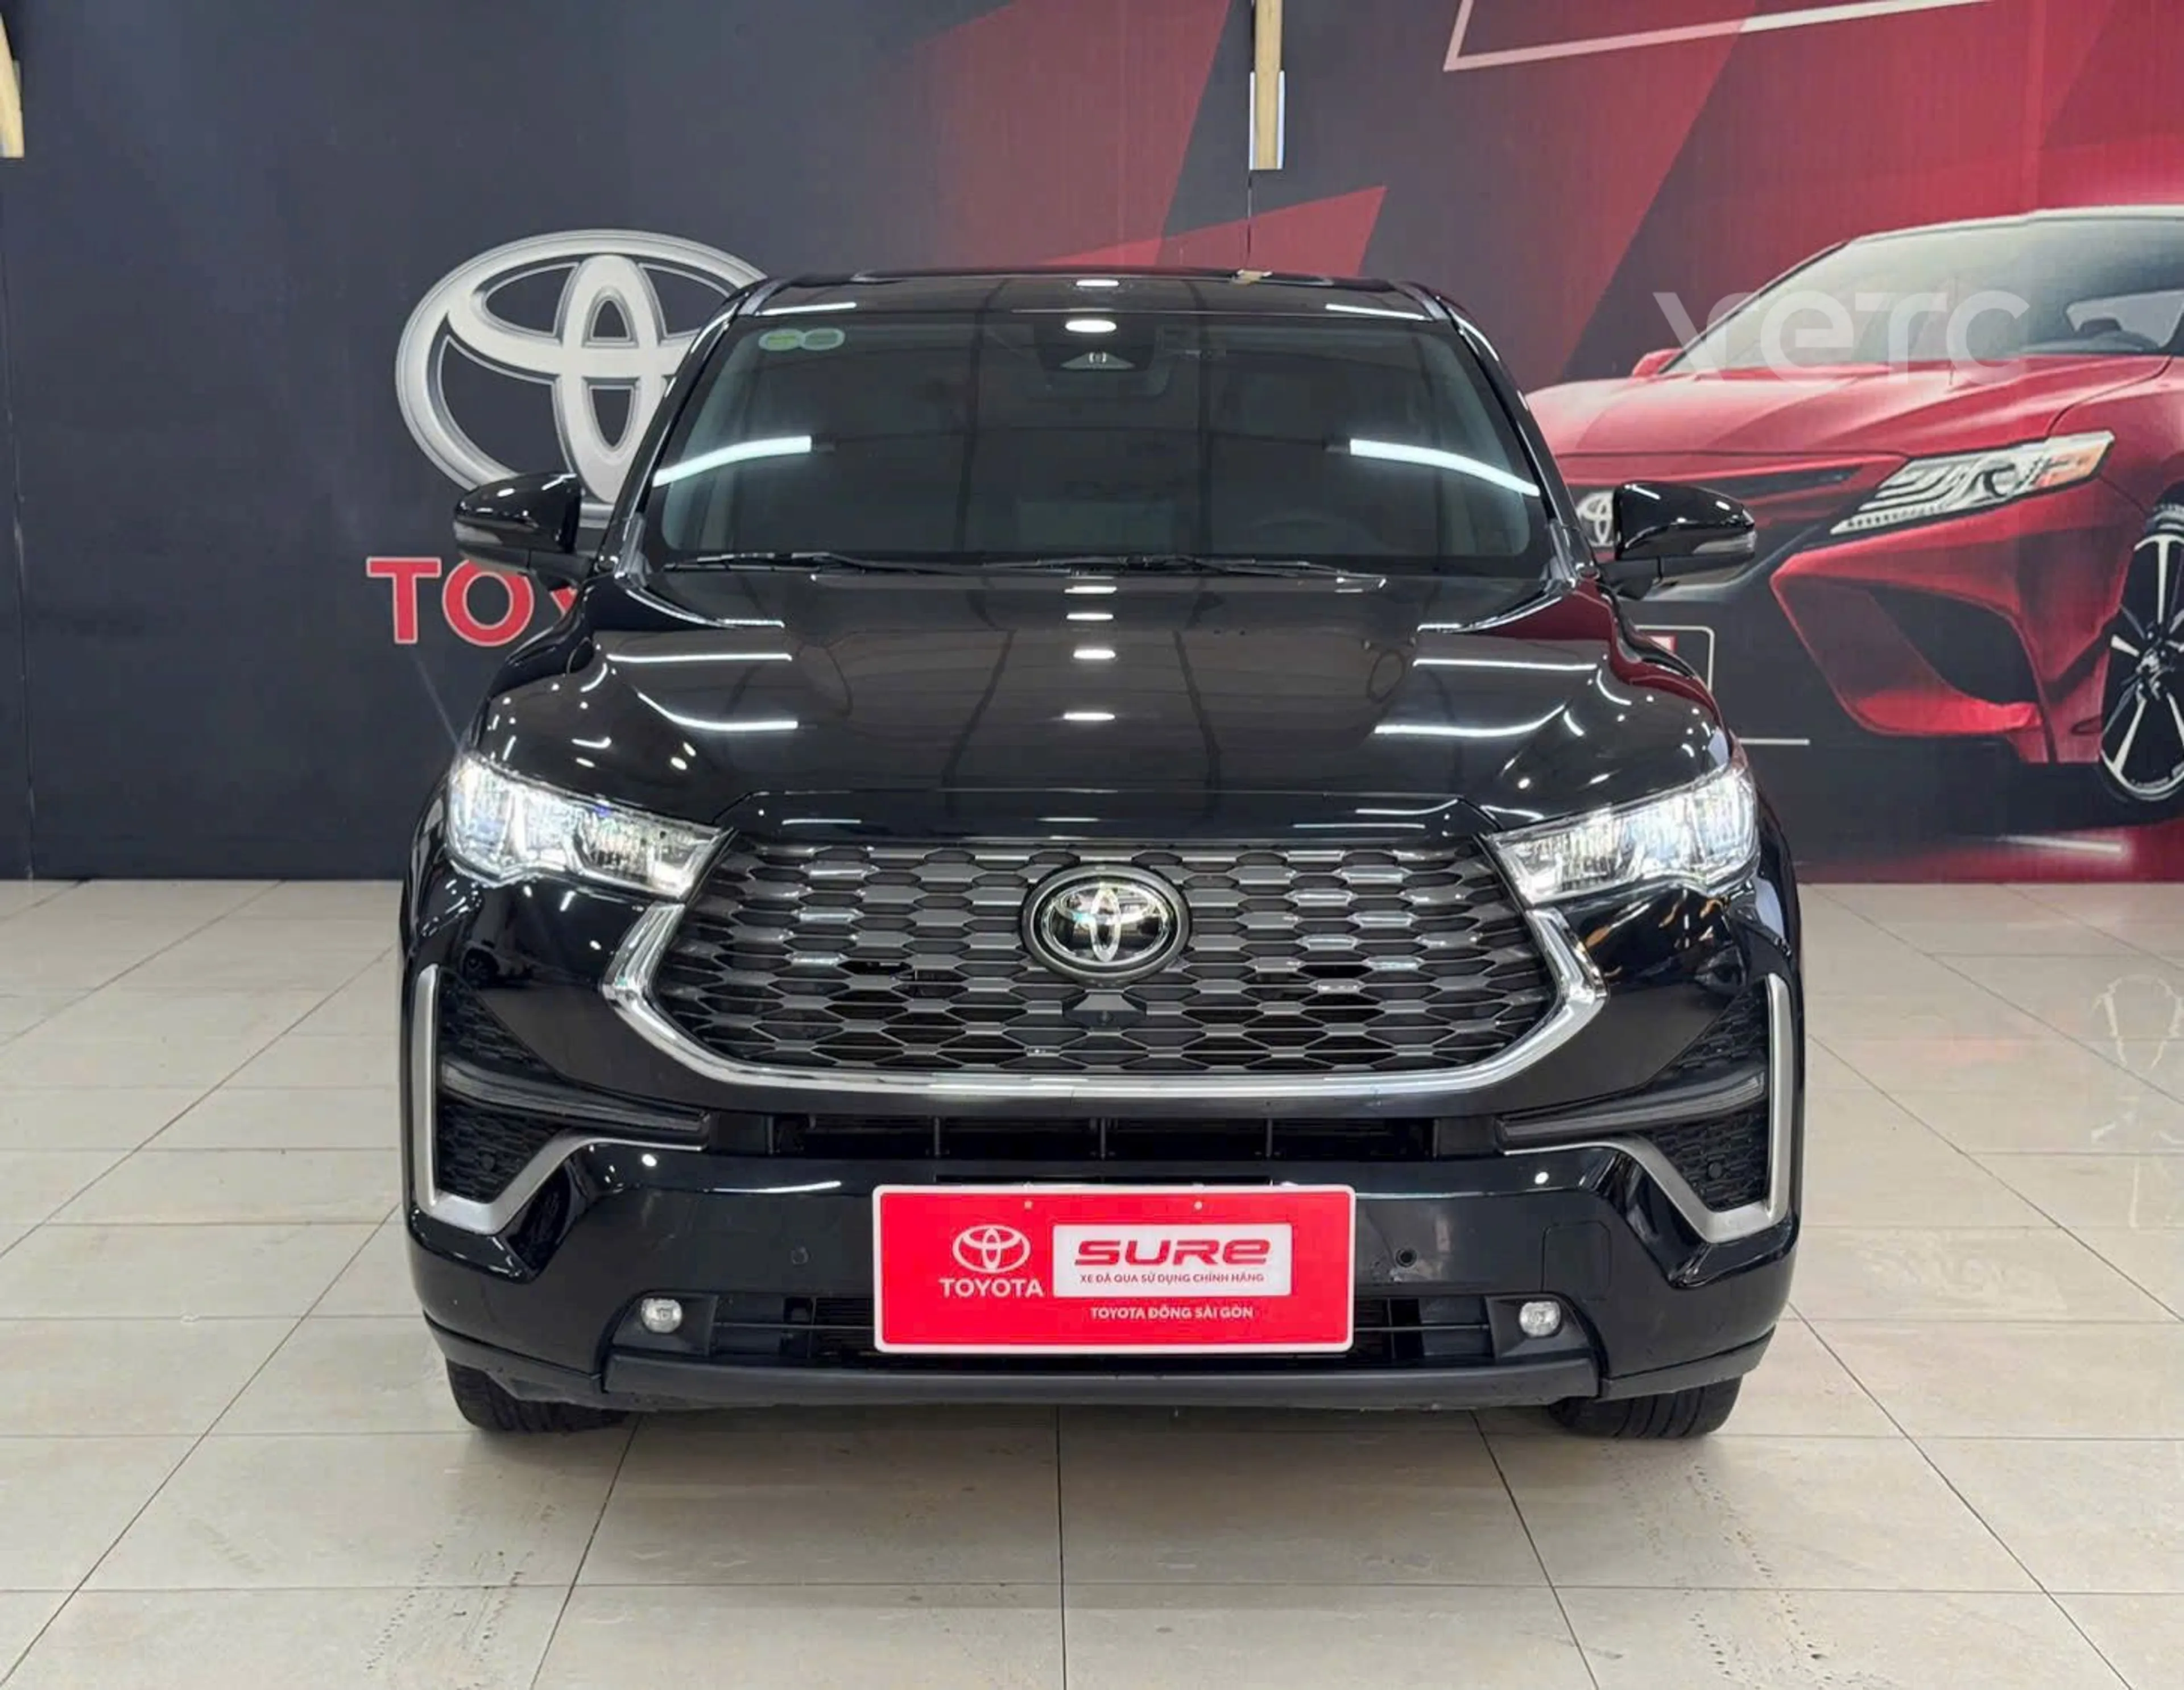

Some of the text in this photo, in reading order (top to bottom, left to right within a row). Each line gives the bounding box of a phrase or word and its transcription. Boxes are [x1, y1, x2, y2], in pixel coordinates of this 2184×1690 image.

[366, 556, 578, 647] TO
[1081, 1274, 1093, 1283] XE
[1114, 1274, 1138, 1283] QUA
[1193, 1271, 1228, 1283] CHÍNH
[939, 1278, 1044, 1298] TOYOTA
[1091, 1304, 1254, 1319] TOYOTA ĐÔNG SÀI GÒN
